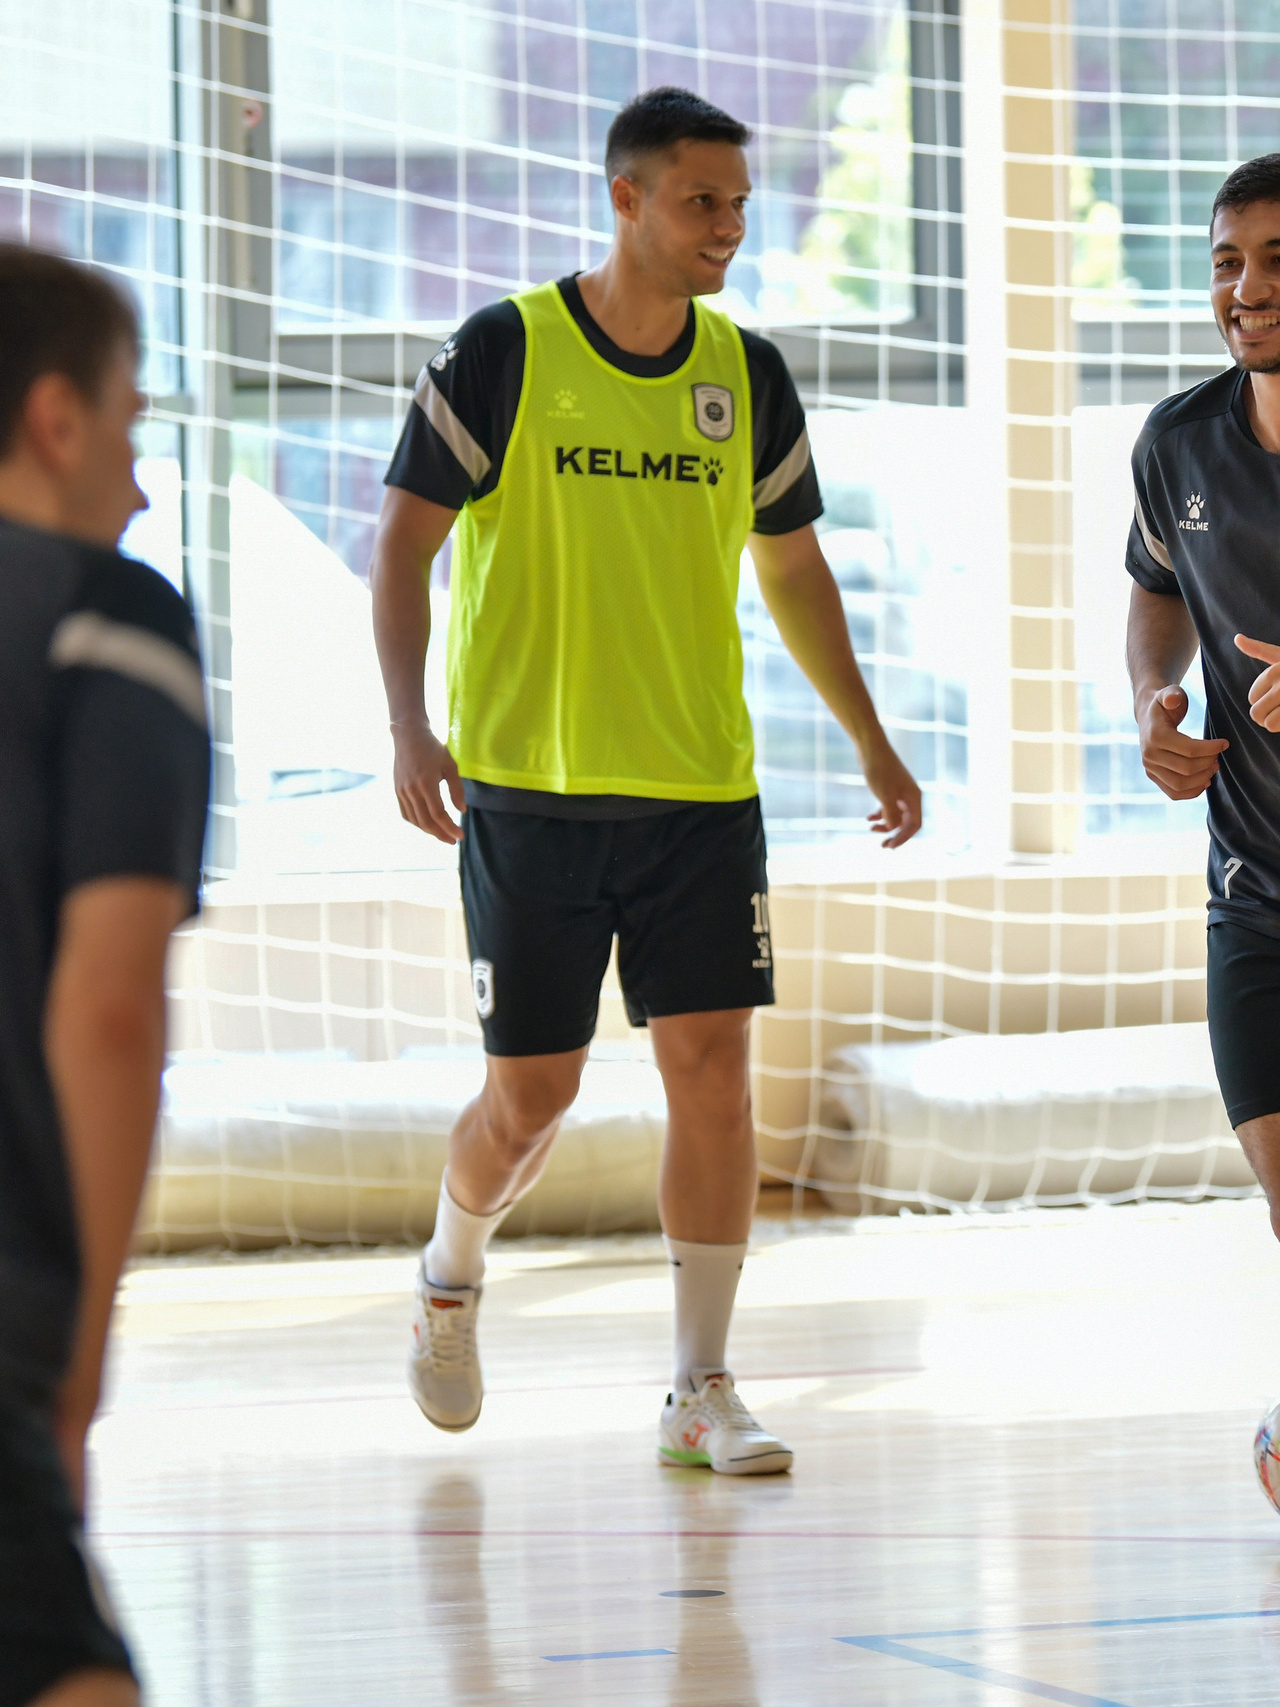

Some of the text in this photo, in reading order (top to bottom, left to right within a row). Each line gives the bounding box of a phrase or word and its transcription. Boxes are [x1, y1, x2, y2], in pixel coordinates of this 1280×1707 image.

[555, 446, 701, 484] KELME
[1178, 519, 1209, 532] KELME
[1223, 856, 1244, 900] 7
